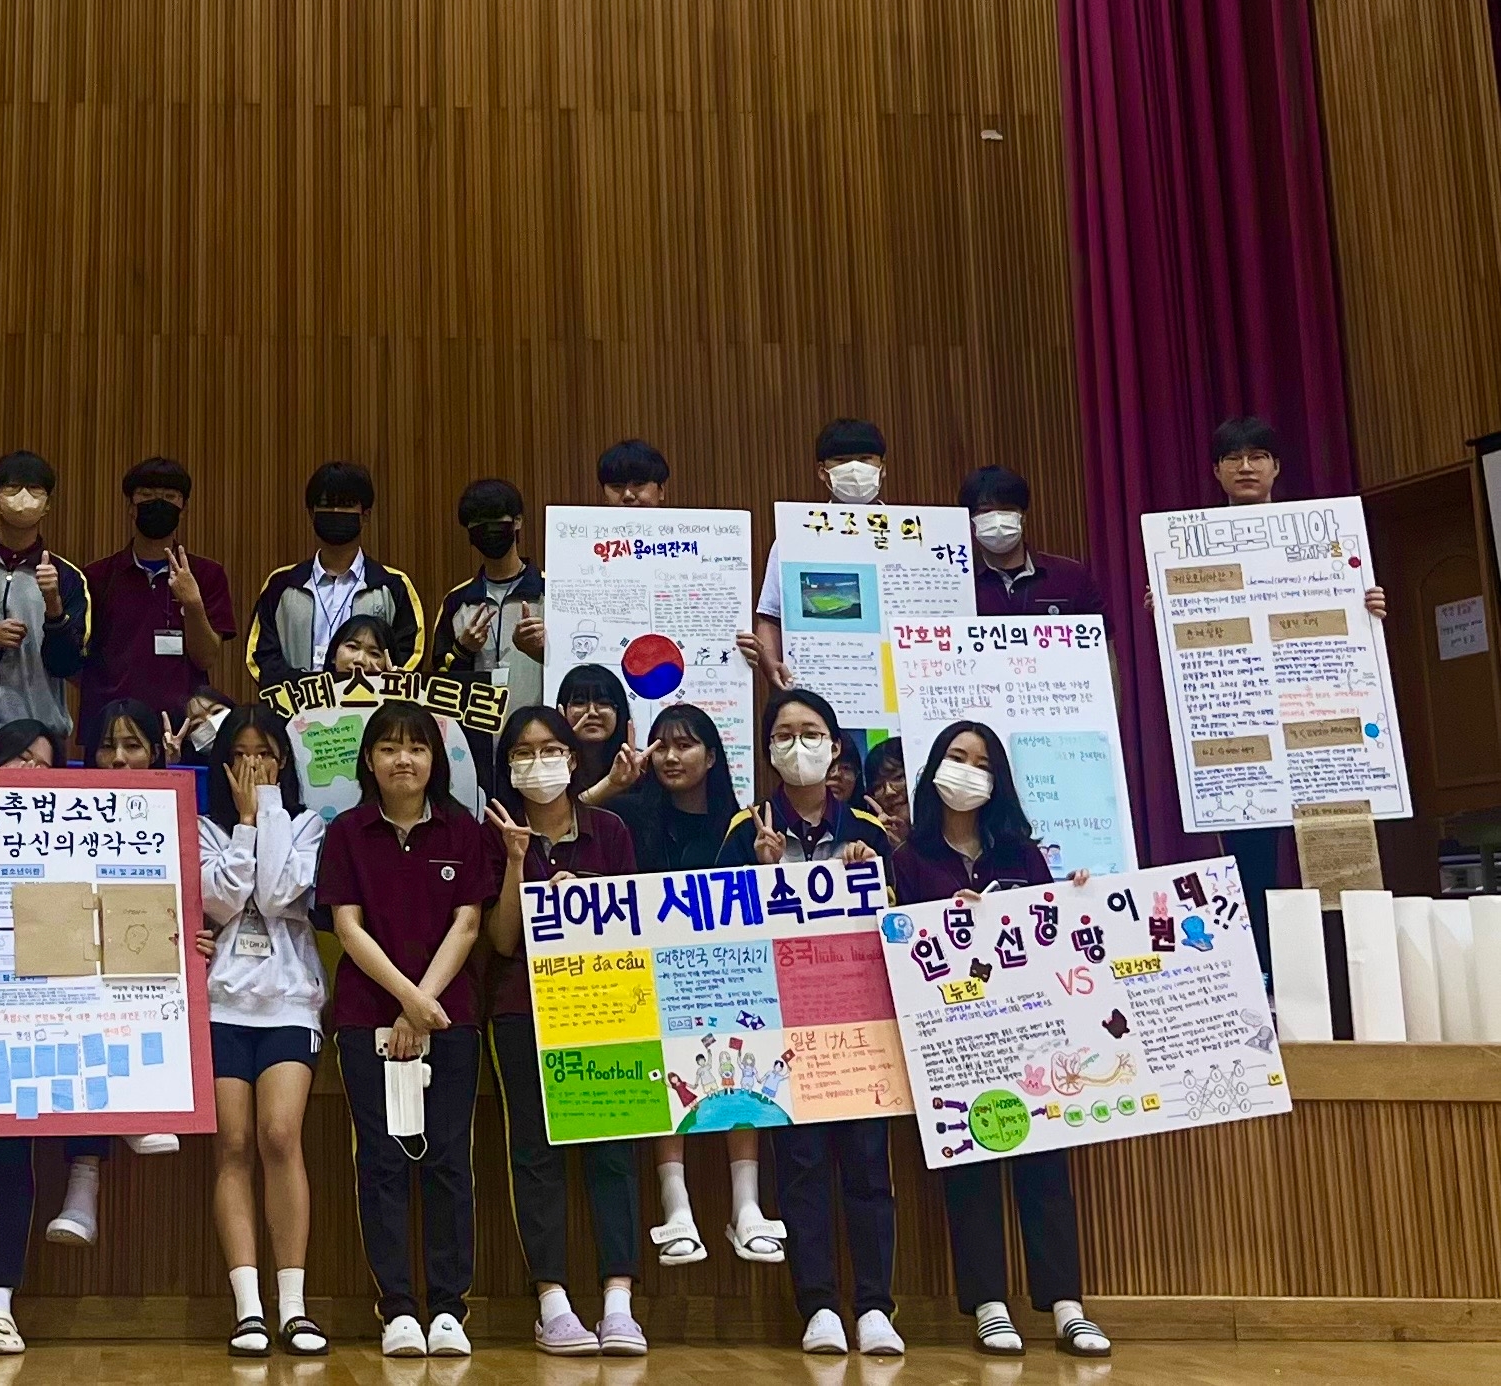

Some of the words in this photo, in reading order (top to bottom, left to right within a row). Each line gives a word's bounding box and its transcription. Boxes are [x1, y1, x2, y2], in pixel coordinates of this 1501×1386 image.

[594, 539, 631, 562] 일제
[930, 544, 970, 574] 하중
[968, 624, 1028, 652] 당신의
[1033, 624, 1102, 649] 생각은?
[903, 658, 977, 678] 간호법이란?
[1008, 657, 1037, 675] 쟁점
[524, 880, 641, 942] 걸어서
[656, 947, 709, 969] 대한민국
[712, 946, 768, 967] 딱지치기
[777, 940, 814, 967] 중국
[533, 955, 585, 977] 베트남
[950, 982, 978, 1001] 뉴런
[1056, 966, 1094, 995] VS
[791, 1030, 816, 1052] 일본
[545, 1051, 584, 1083] 영국
[586, 1060, 643, 1080] football
